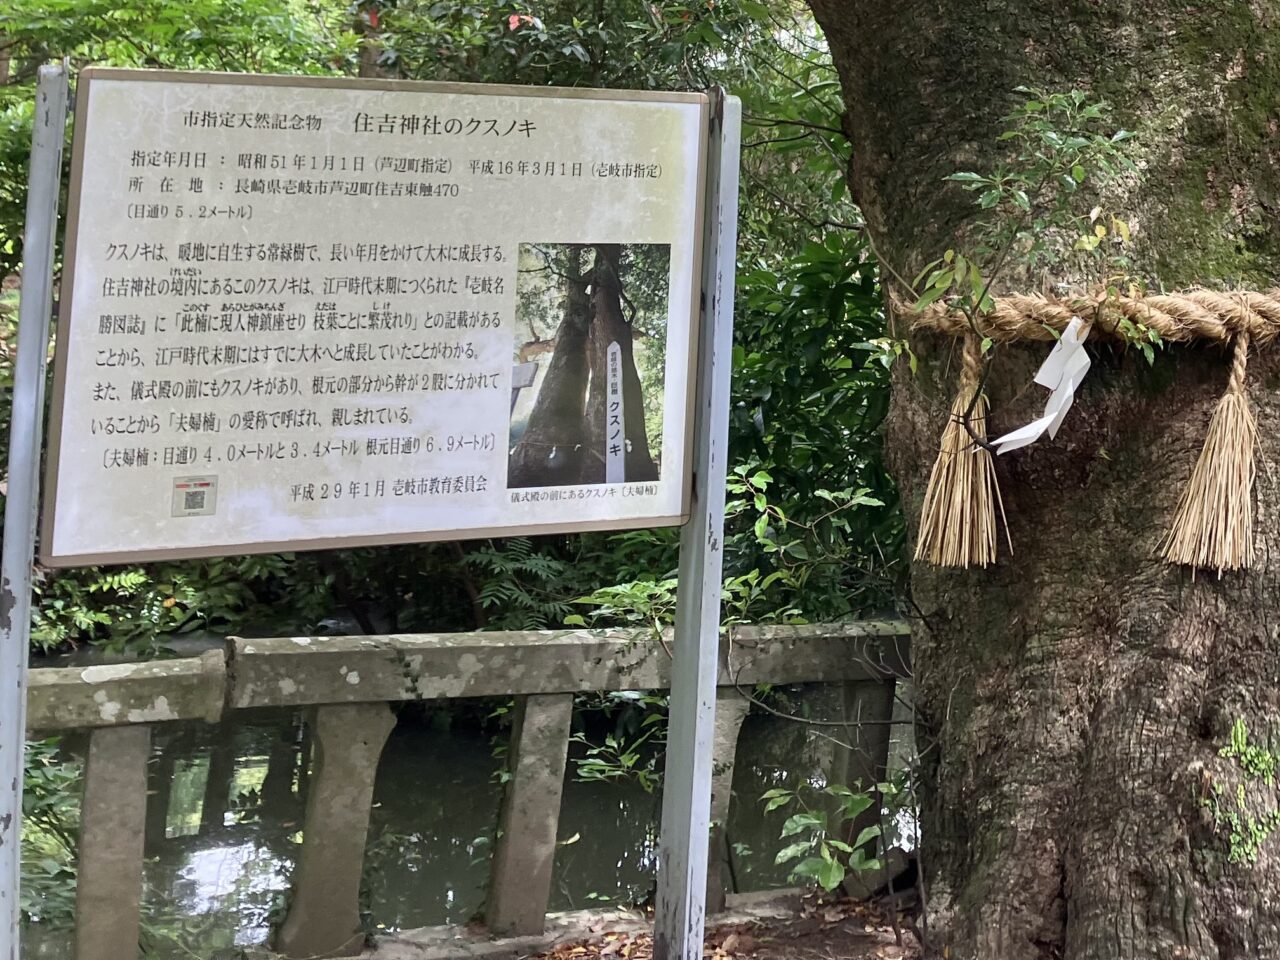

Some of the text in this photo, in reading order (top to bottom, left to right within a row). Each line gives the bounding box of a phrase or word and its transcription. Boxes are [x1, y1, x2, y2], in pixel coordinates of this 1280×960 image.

[183, 111, 537, 138] 市指定天然記念物 住吉神社のクスノキ
[105, 242, 506, 264] クスノキは、暖地に自生する常緑樹で、長い年月をかけて大木に成長する。
[102, 276, 504, 297] 住吉神社の境内にあるこのクスノキは、江戸時代末期につくられた『壱岐名
[95, 342, 479, 367] ことから、江戸時代末期にはすでに大木へと成長していたことがわかる。
[91, 406, 413, 435] いることから「夫婦楠」の愛称で呼ばれ、親しまれている。
[609, 401, 622, 457] クスノキ
[392, 475, 487, 496] 壱岐市教育委員会
